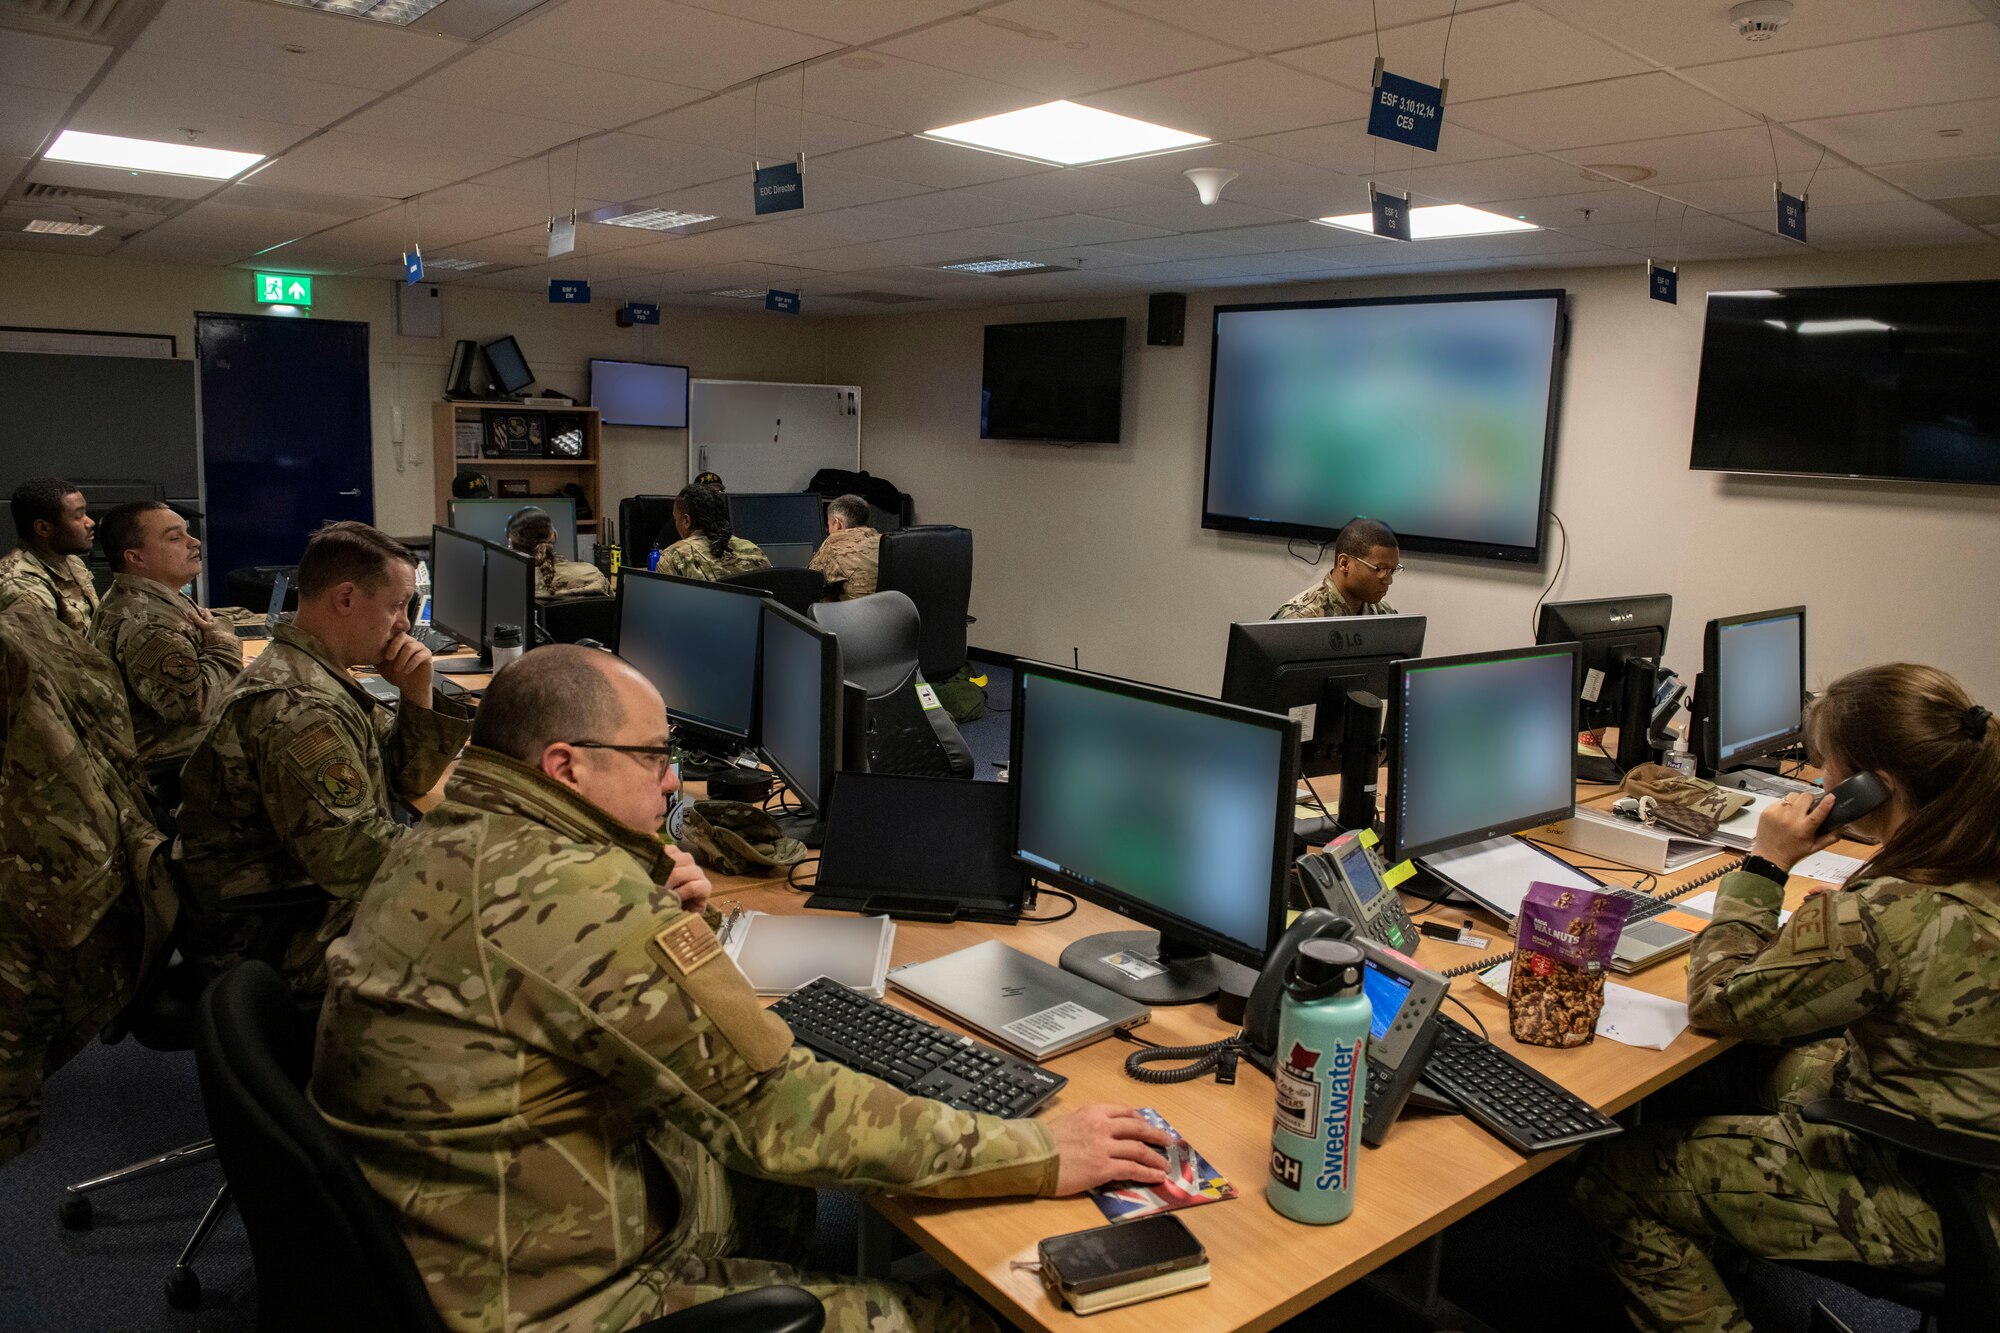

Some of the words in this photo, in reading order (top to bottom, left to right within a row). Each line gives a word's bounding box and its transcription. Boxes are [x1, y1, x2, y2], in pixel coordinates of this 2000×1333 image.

[1380, 91, 1398, 107] ESF
[1399, 97, 1435, 119] 3,10,12,14
[1396, 114, 1414, 130] CES
[760, 186, 772, 197] EOC
[773, 183, 796, 195] Director
[1384, 206, 1394, 216] ESF
[1346, 632, 1363, 647] LG
[1533, 922, 1580, 945] WALNUTS
[1316, 1042, 1353, 1191] Sweetwater
